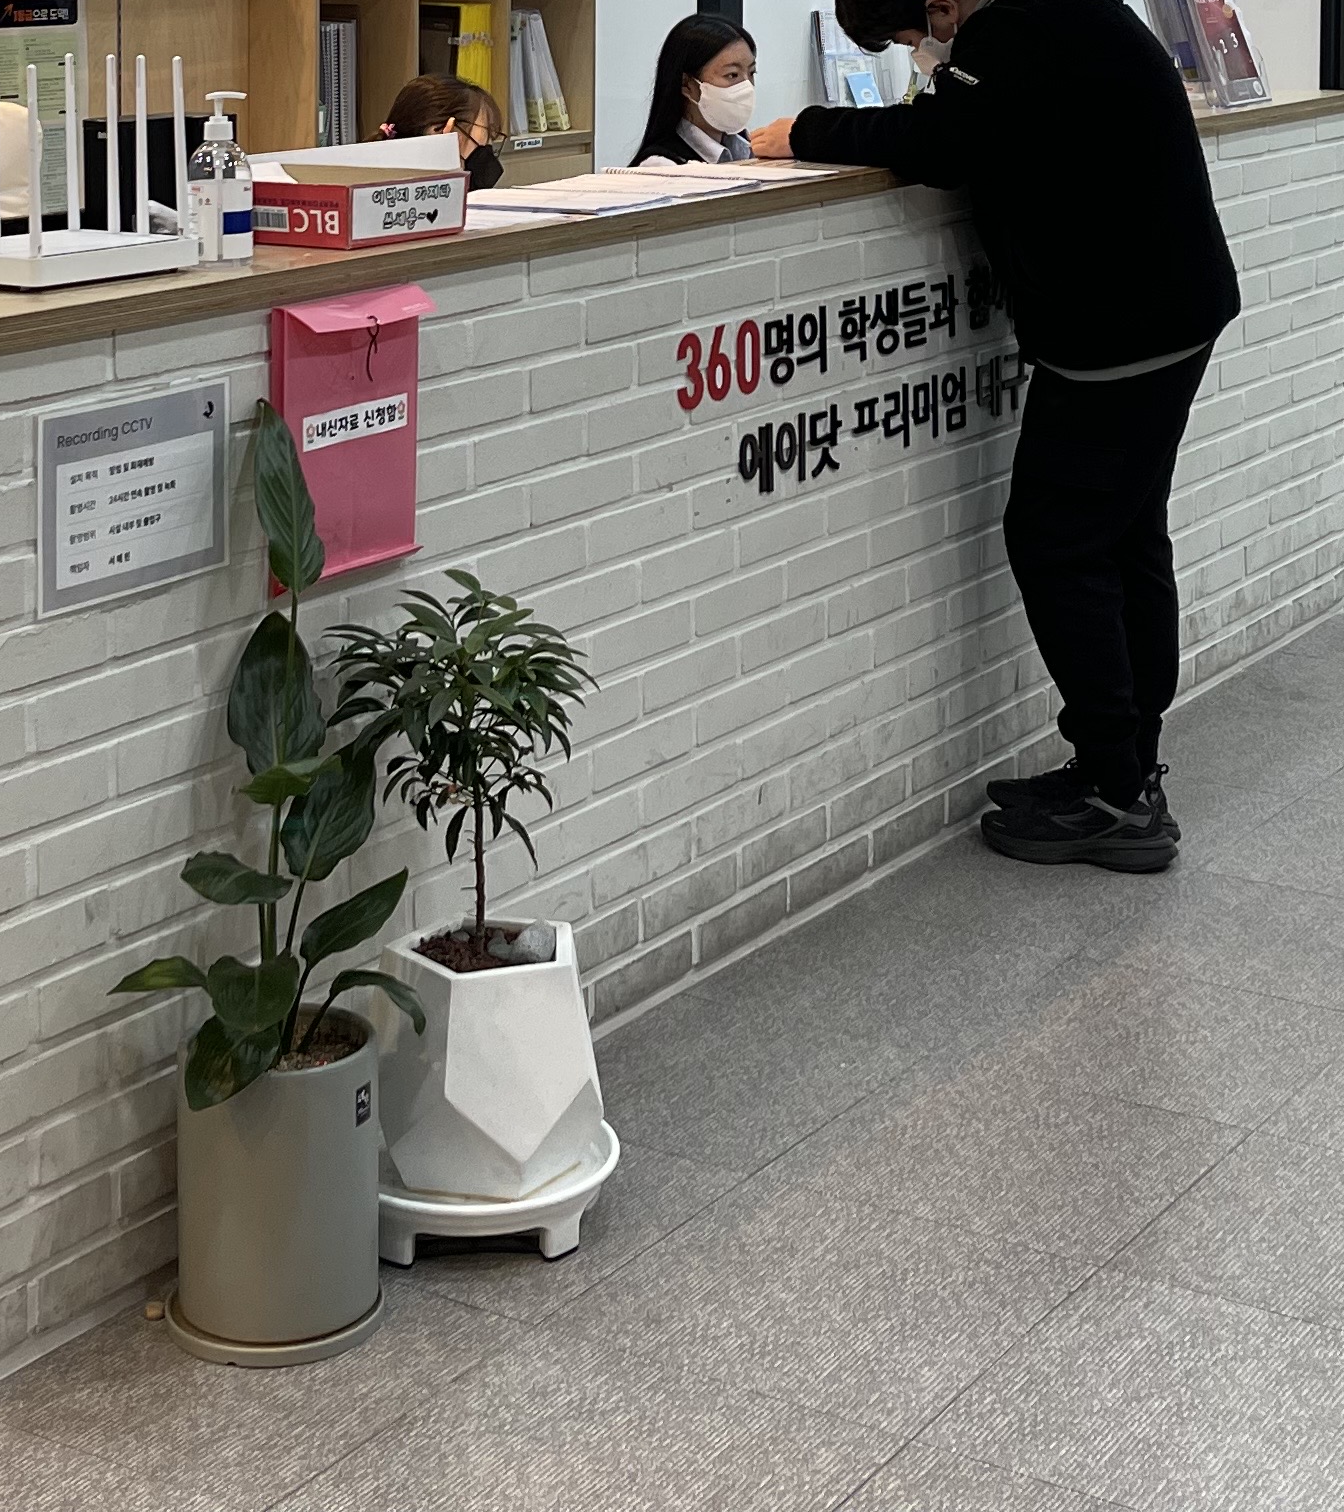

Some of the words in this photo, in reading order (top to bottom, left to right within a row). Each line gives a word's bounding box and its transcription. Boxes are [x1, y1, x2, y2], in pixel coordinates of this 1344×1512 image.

[294, 208, 341, 236] BLC
[676, 305, 828, 411] 360명의
[838, 274, 959, 363] 학생들과
[57, 426, 119, 449] Recording
[121, 417, 153, 435] CCTV
[316, 413, 359, 438] 내신자료
[363, 403, 397, 429] 신청함
[739, 403, 843, 494] 에이닷
[852, 366, 967, 448] 프리미엄
